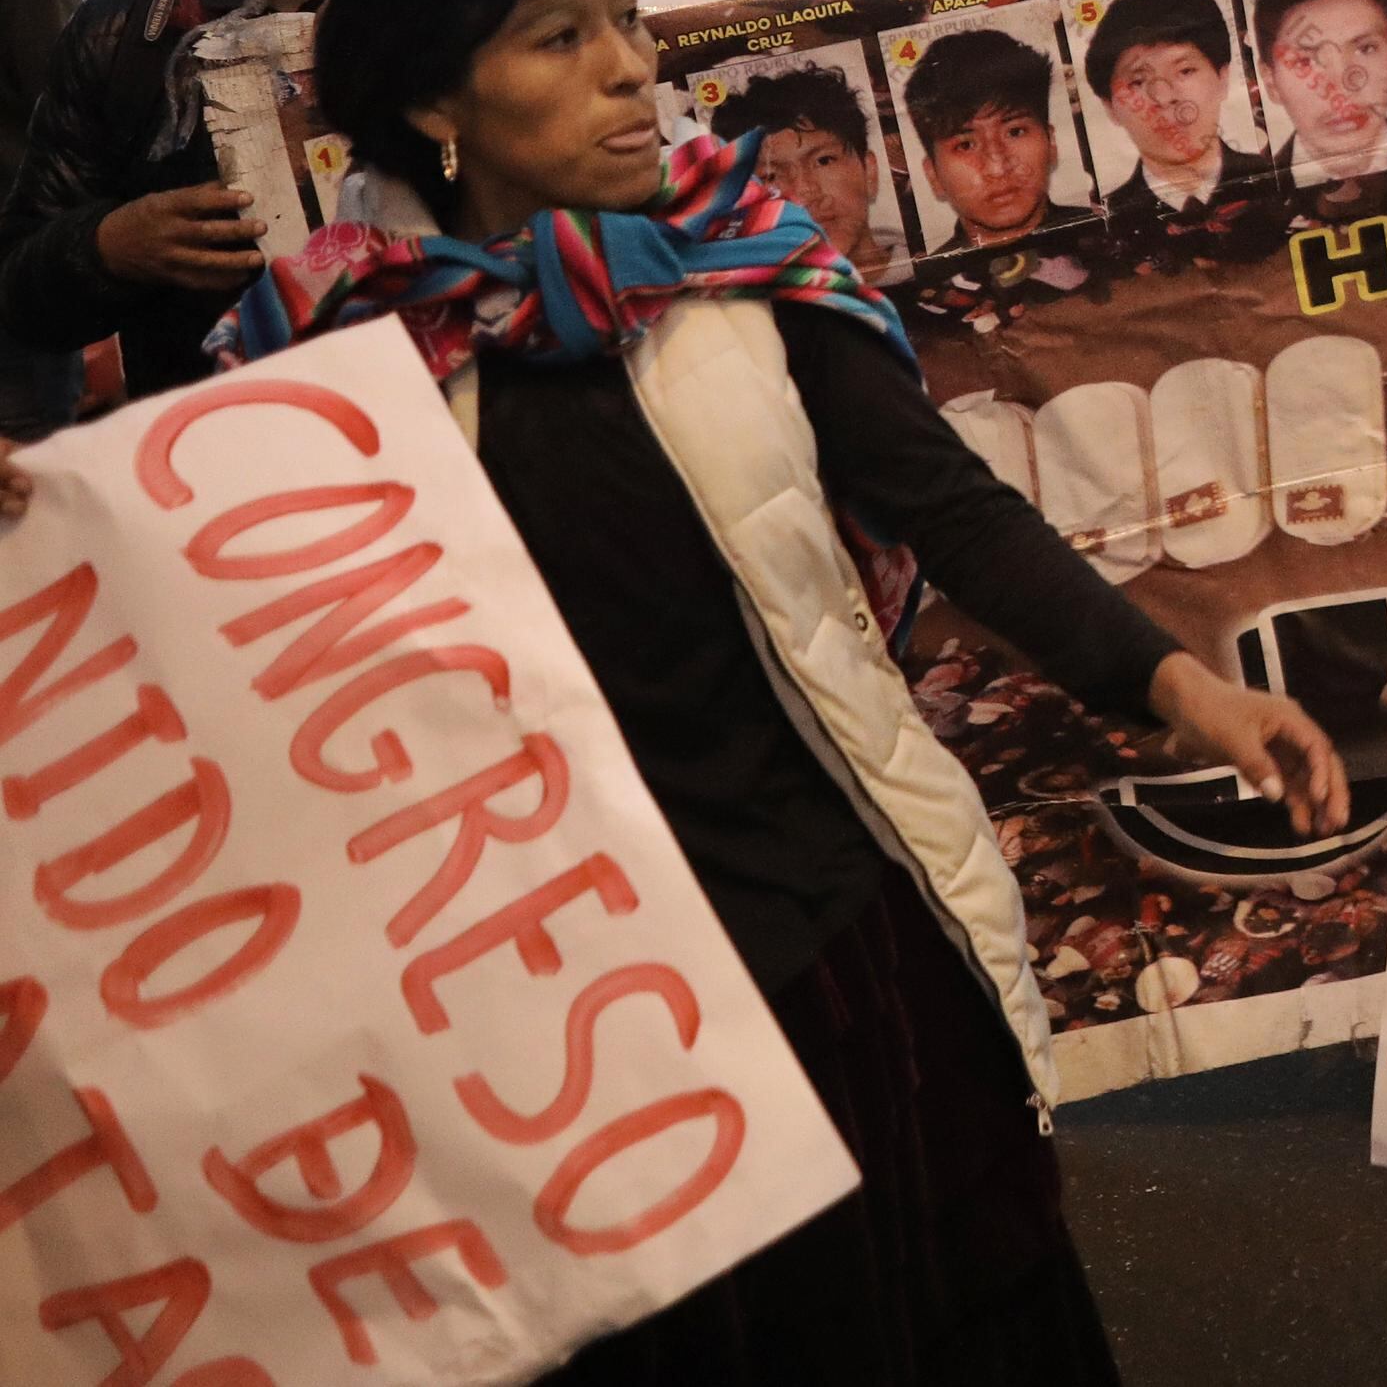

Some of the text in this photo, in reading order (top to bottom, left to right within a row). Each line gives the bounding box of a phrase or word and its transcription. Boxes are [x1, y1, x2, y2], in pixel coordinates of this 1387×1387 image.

[1081, 1, 1098, 22] 5
[677, 15, 771, 49] REYNALDO
[776, 0, 854, 27] ILAQUITA
[747, 31, 795, 53] CRUZ
[898, 40, 917, 61] 4
[701, 82, 720, 103] 3
[316, 147, 333, 169] 1
[134, 379, 747, 1257] CONGRESO
[202, 1072, 510, 1367] DE
